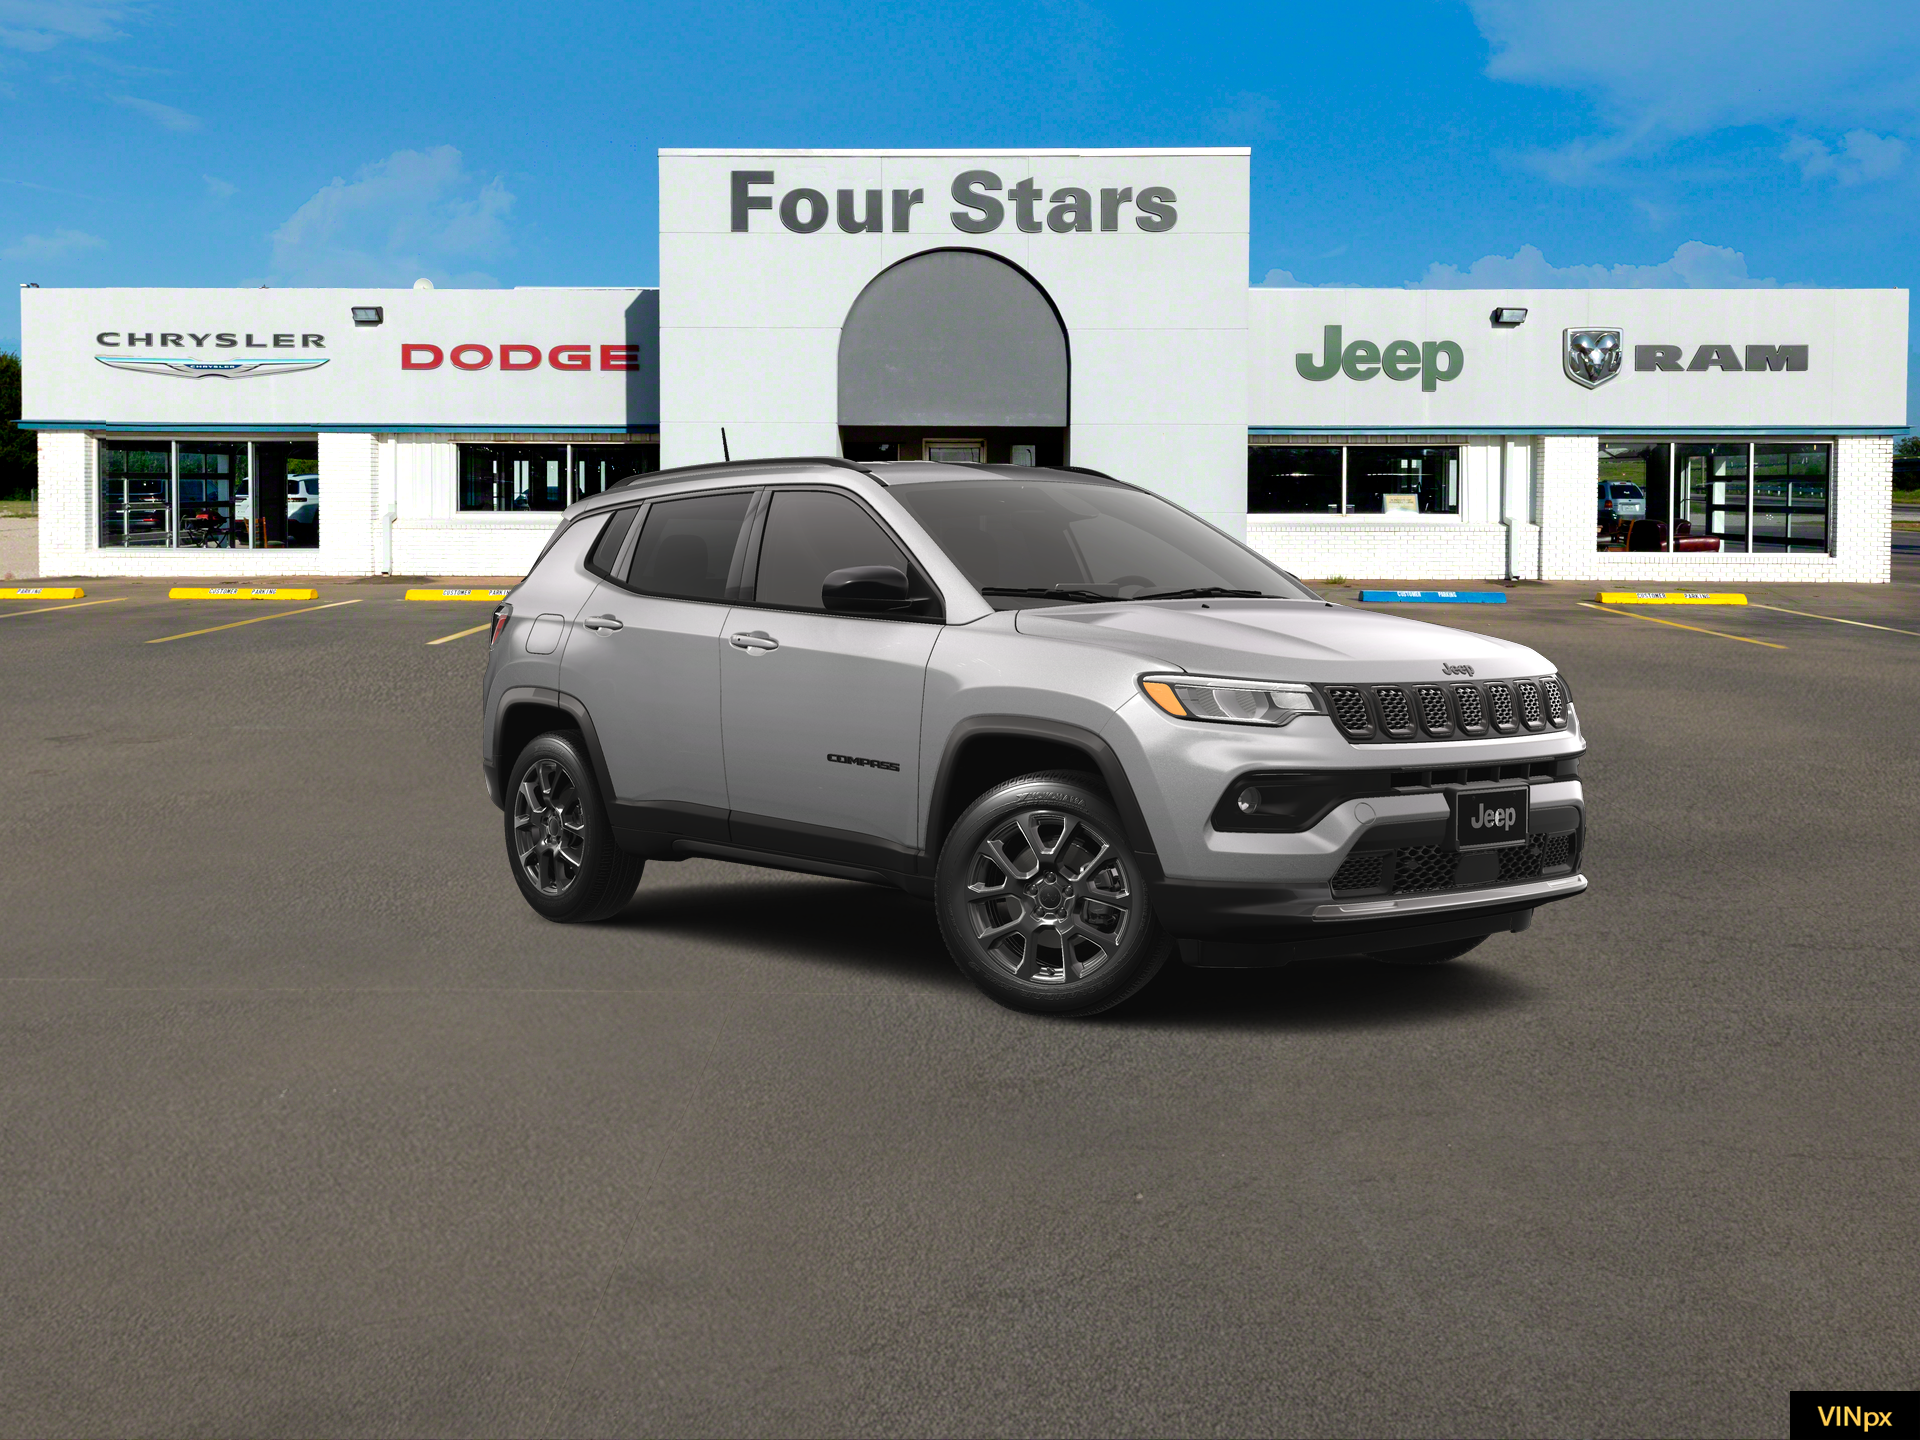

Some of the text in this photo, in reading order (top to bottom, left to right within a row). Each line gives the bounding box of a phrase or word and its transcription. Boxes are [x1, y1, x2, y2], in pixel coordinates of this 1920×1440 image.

[731, 169, 1178, 234] Four Stars
[96, 331, 326, 349] CHRYSLER
[401, 343, 640, 371] DODGE
[1295, 324, 1464, 393] Jeep
[1634, 344, 1809, 372] RAM
[1442, 662, 1475, 677] Jeep
[826, 753, 900, 772] COMPASS
[1471, 803, 1516, 831] Jeep
